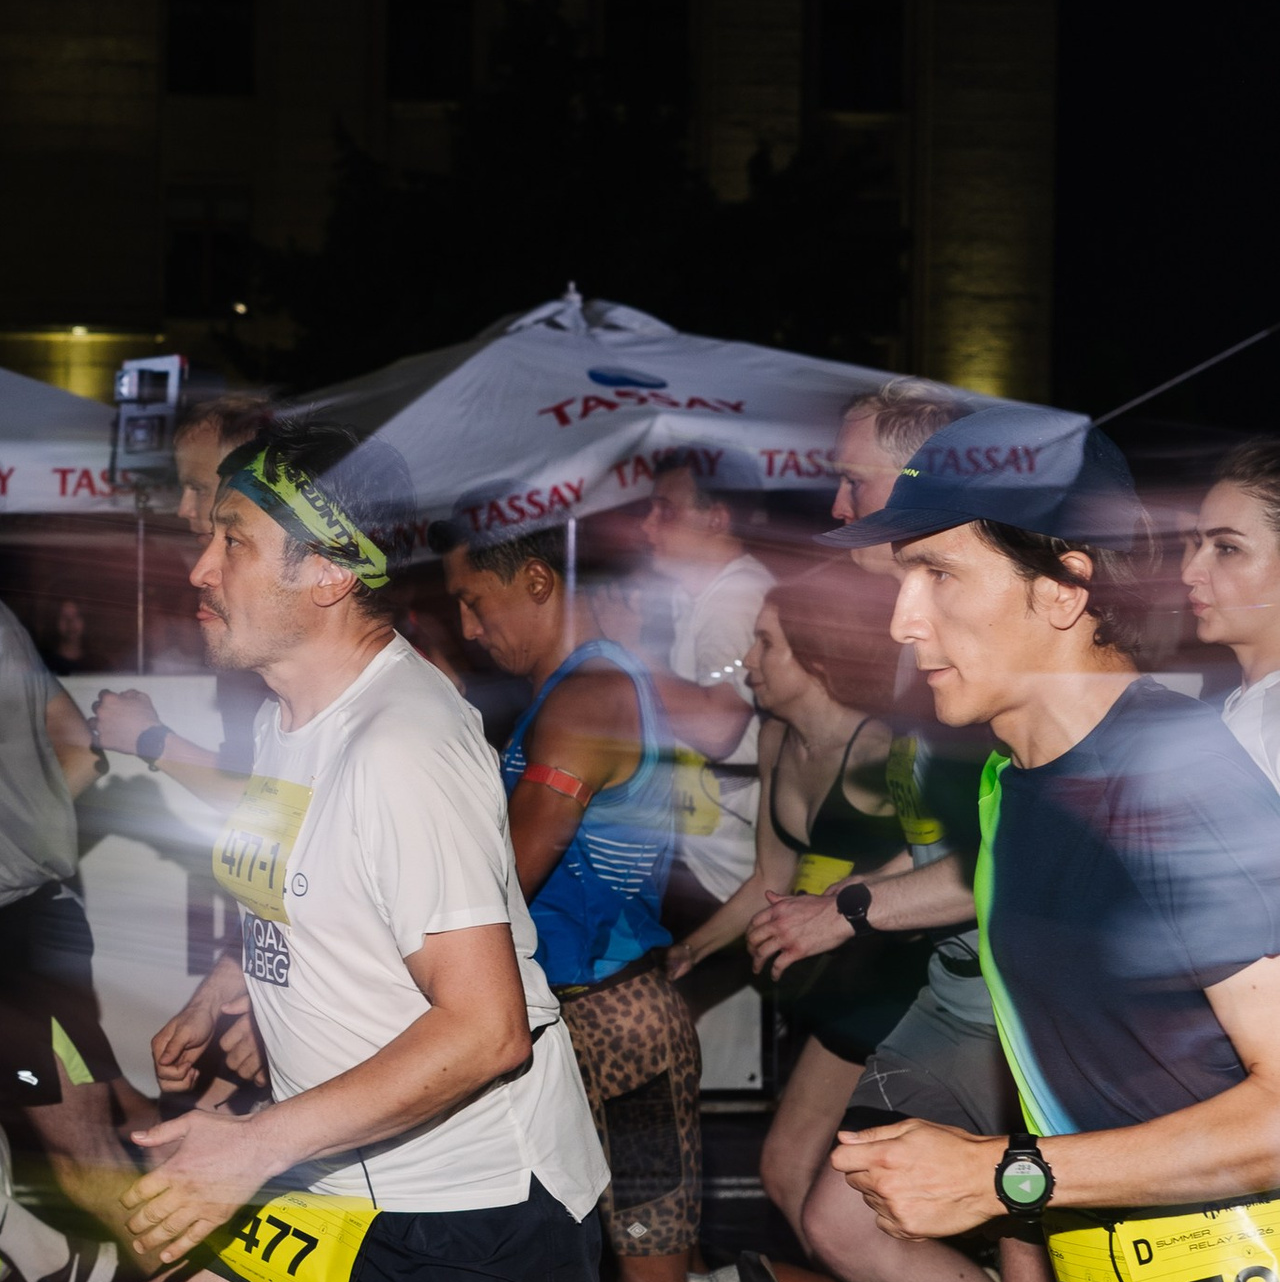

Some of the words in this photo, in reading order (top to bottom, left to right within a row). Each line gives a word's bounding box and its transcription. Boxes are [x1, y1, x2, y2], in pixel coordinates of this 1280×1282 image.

[537, 389, 747, 428] TASSAY
[52, 467, 144, 498] TASS
[464, 477, 585, 534] TASSAY
[612, 446, 724, 490] TAAY
[760, 447, 838, 478] TASS
[923, 445, 1043, 475] TASSAY
[221, 828, 281, 890] 477-1
[254, 948, 289, 984] BEG
[228, 1213, 320, 1277] 477
[1132, 1238, 1154, 1266] D
[1155, 1228, 1212, 1249] SUMMER
[1188, 1235, 1234, 1252] RELAY
